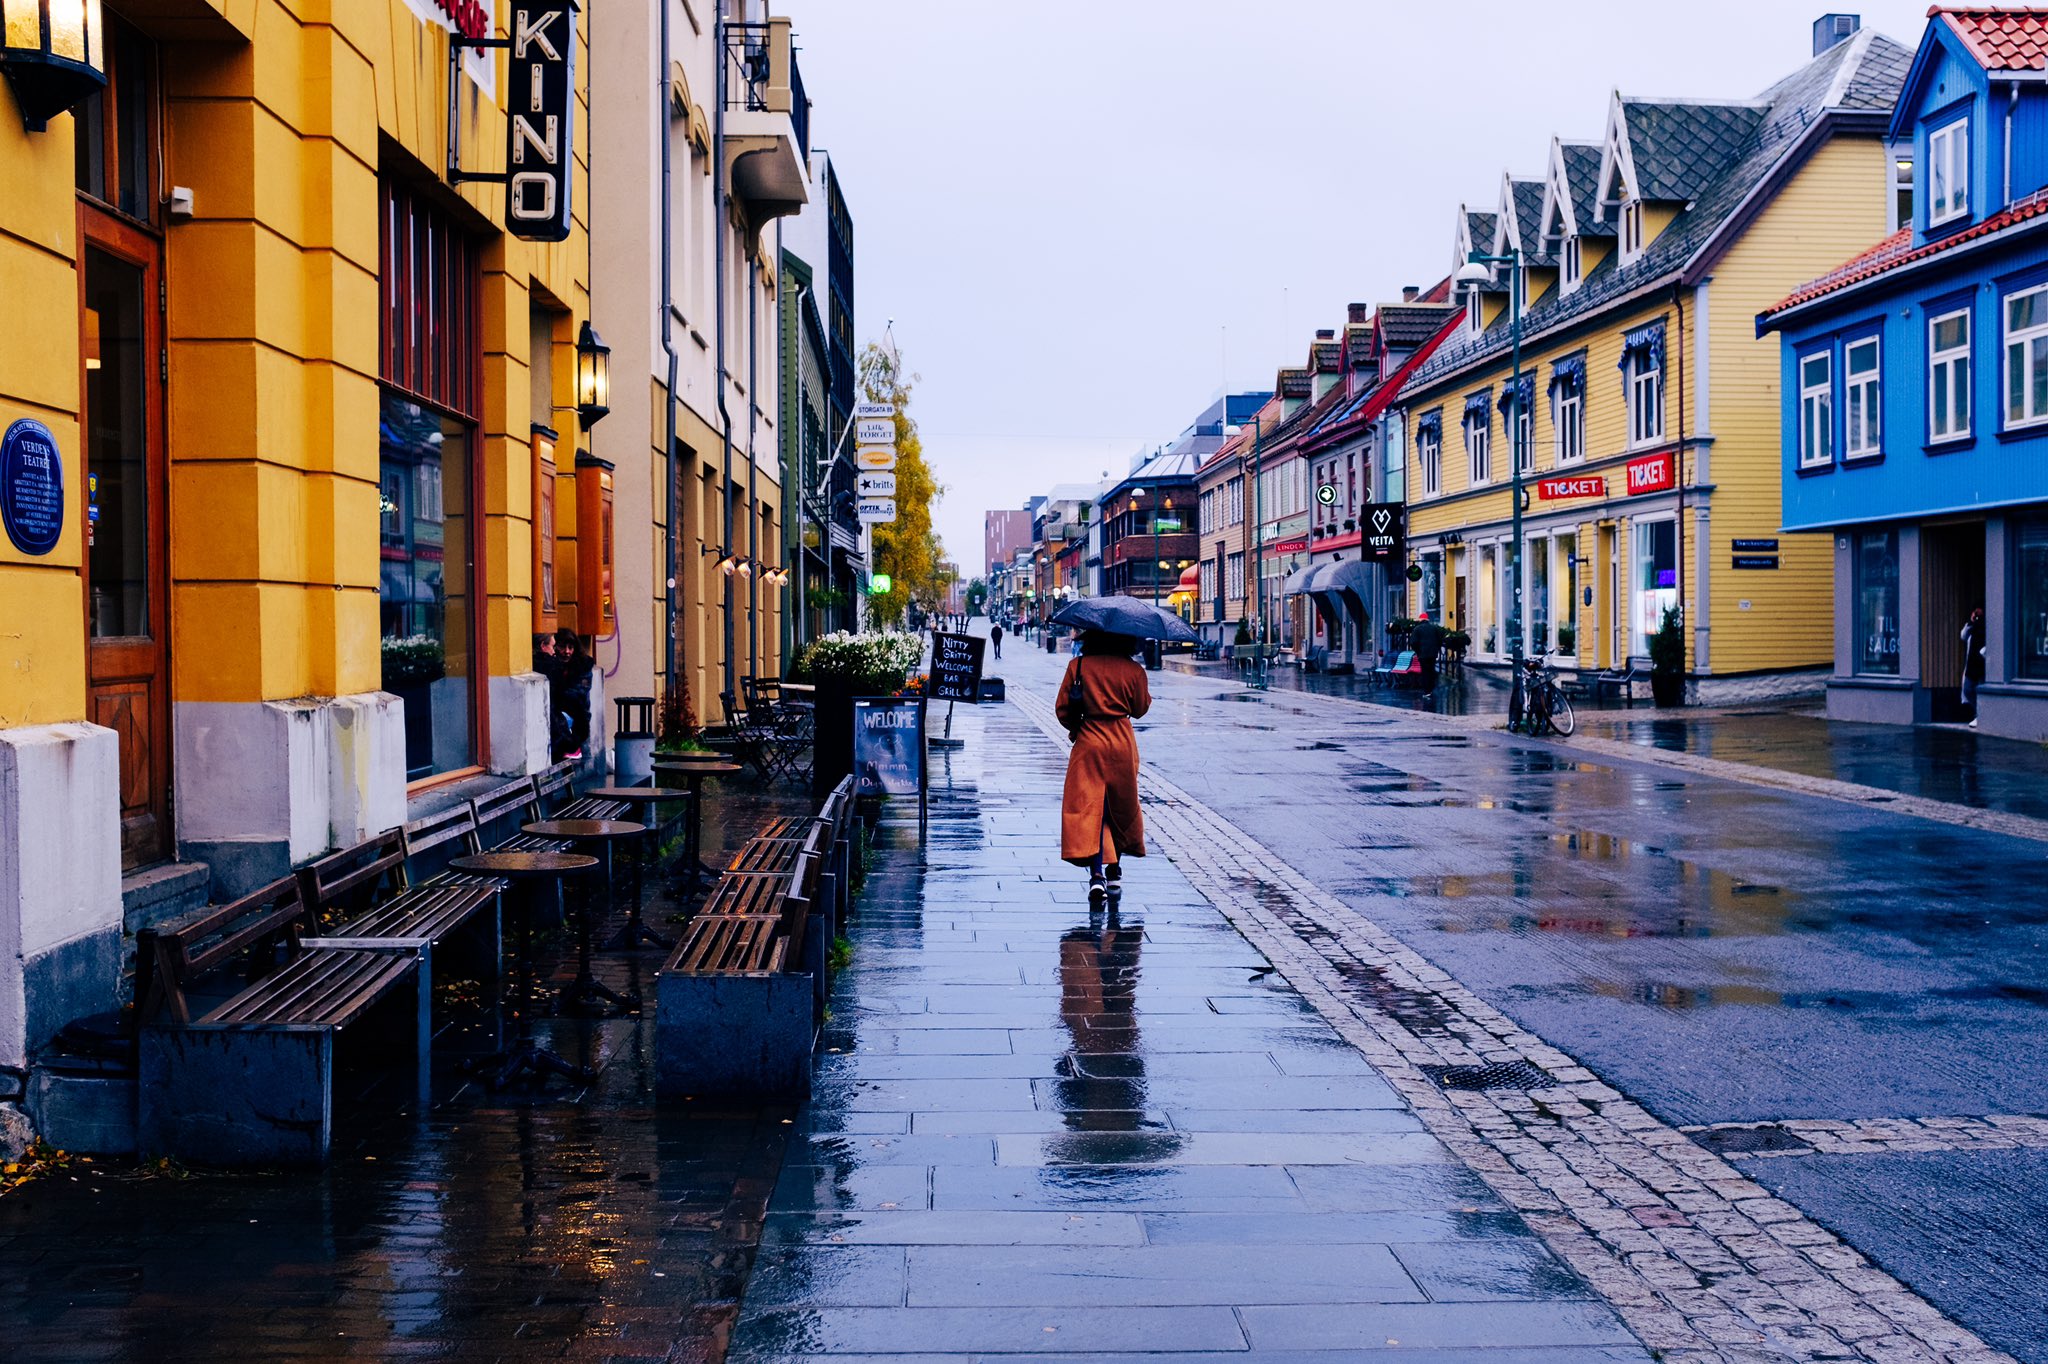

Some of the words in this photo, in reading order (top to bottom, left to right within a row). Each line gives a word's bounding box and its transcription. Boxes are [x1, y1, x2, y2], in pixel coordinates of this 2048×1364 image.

[511, 10, 562, 221] KINO
[21, 440, 51, 456] VERDENS
[1629, 460, 1664, 487] TICKET
[872, 479, 894, 489] britts
[1545, 480, 1598, 496] TICKET
[1369, 536, 1394, 546] VEITA
[1878, 616, 1895, 633] TIL
[934, 658, 974, 673] WELCOME
[943, 674, 959, 683] BAR
[863, 711, 916, 729] WELCOME
